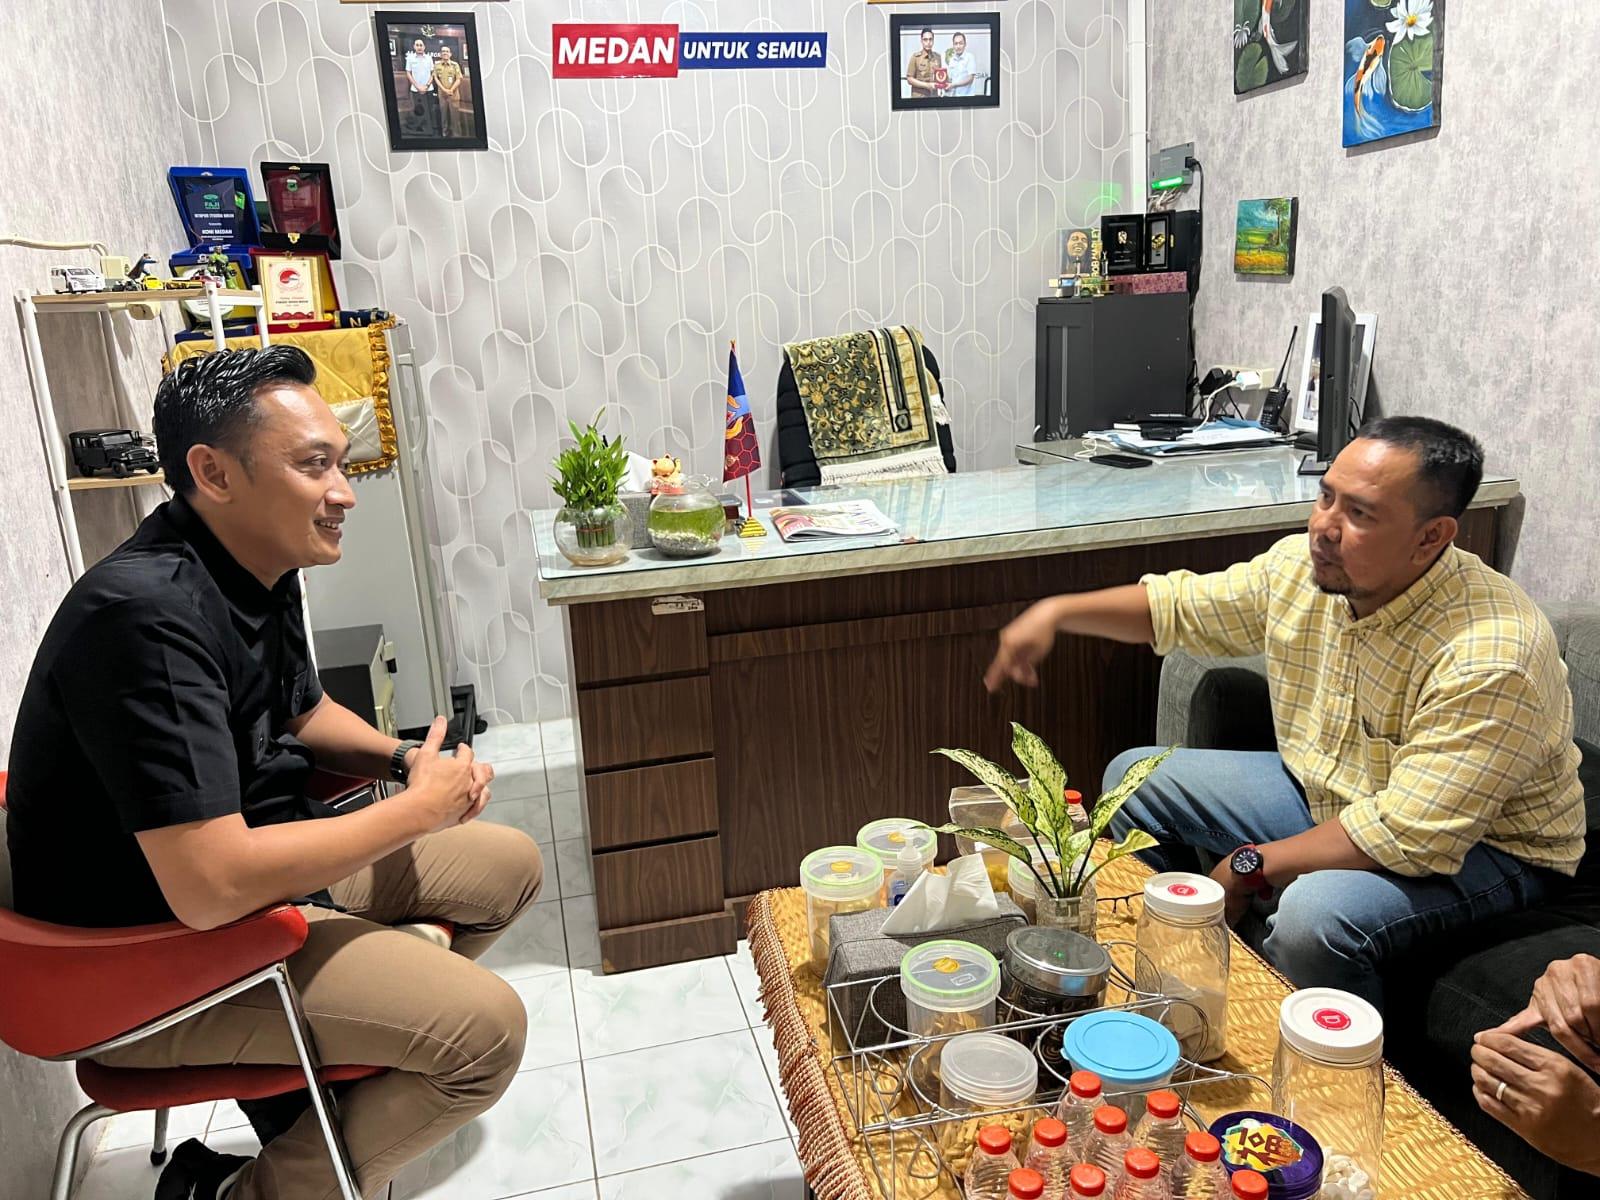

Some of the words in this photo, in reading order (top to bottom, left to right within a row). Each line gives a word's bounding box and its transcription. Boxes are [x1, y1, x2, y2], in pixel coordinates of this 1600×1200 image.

[558, 37, 675, 64] MEDAN
[683, 42, 749, 60] UNTUK
[756, 41, 822, 59] SEMUA
